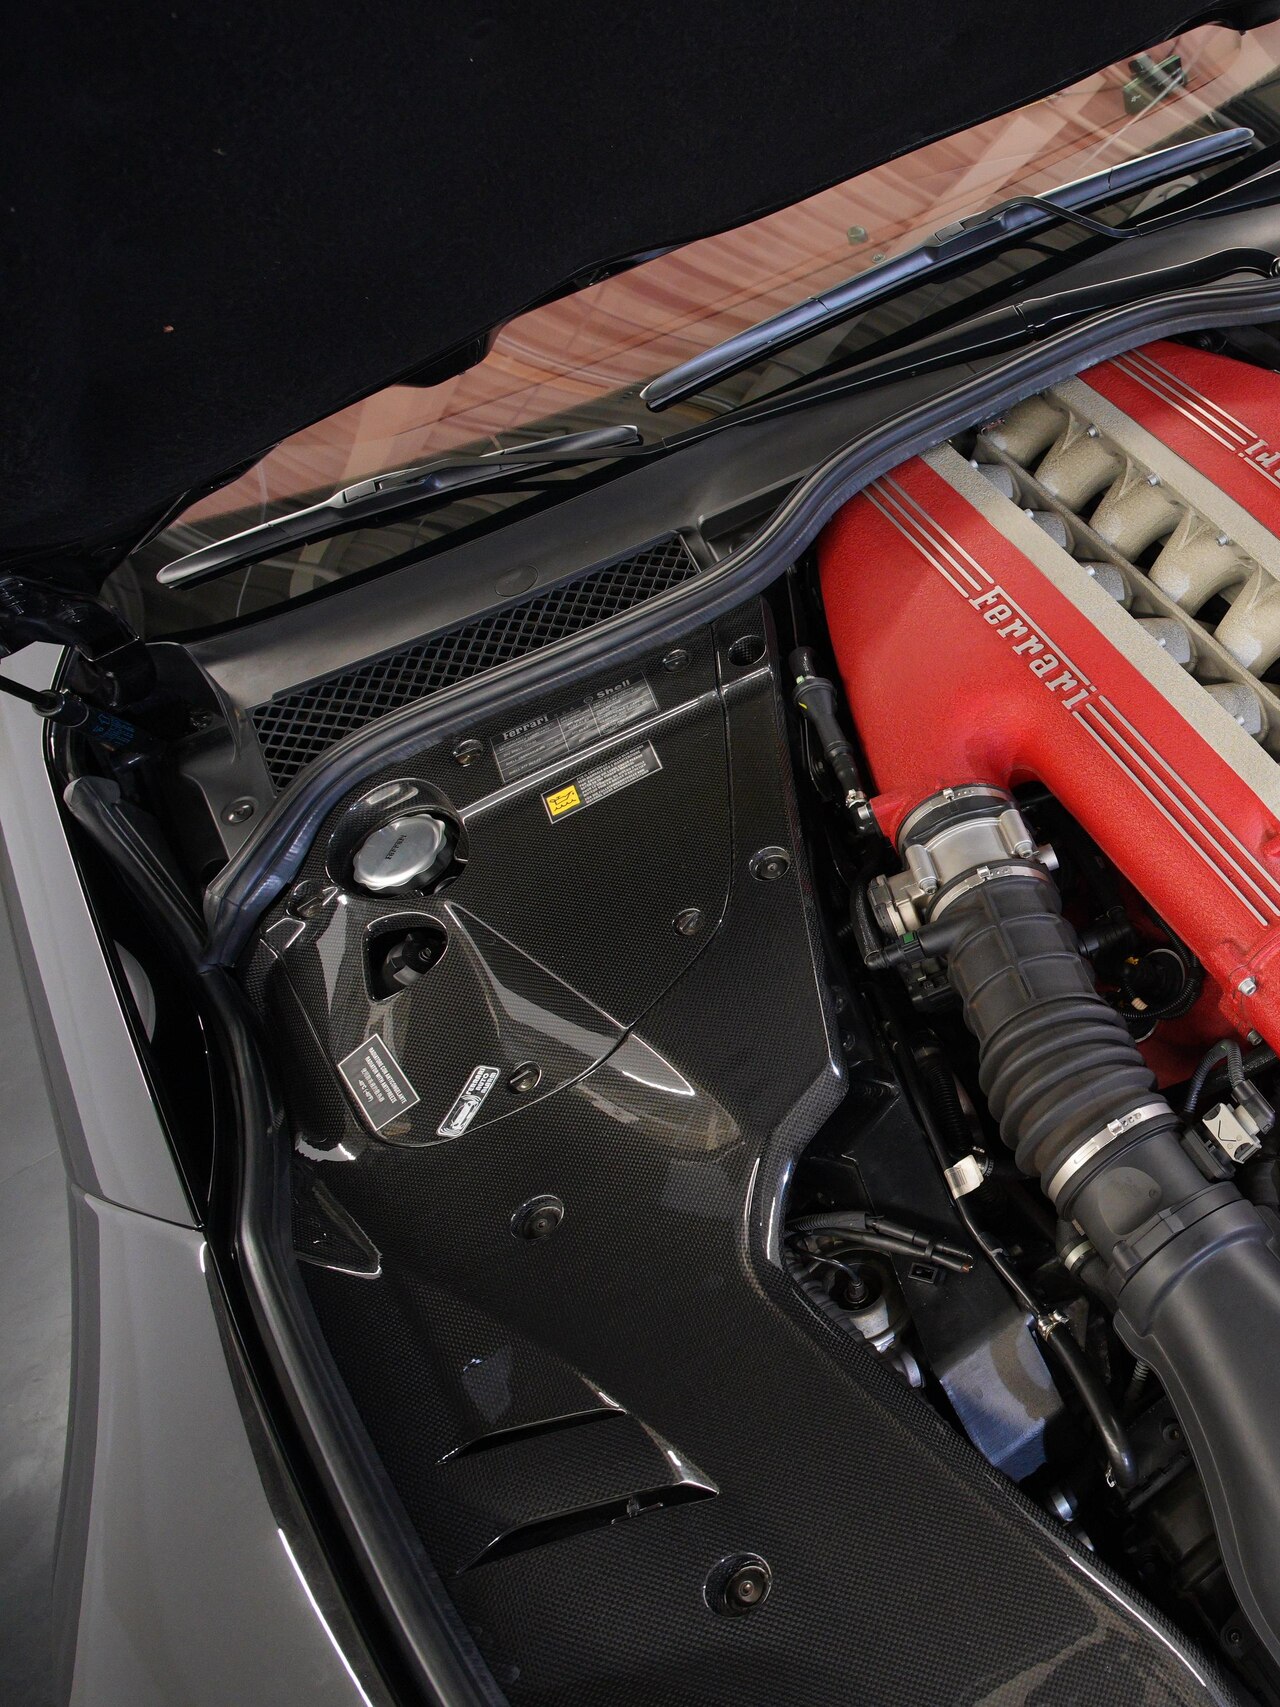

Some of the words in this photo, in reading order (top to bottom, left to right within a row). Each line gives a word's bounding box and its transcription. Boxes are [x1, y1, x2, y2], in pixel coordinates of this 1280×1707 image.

[968, 585, 1098, 711] Ferrari
[596, 679, 631, 699] Shell
[501, 714, 550, 741] Ferrari
[474, 1072, 490, 1090] AUTO
